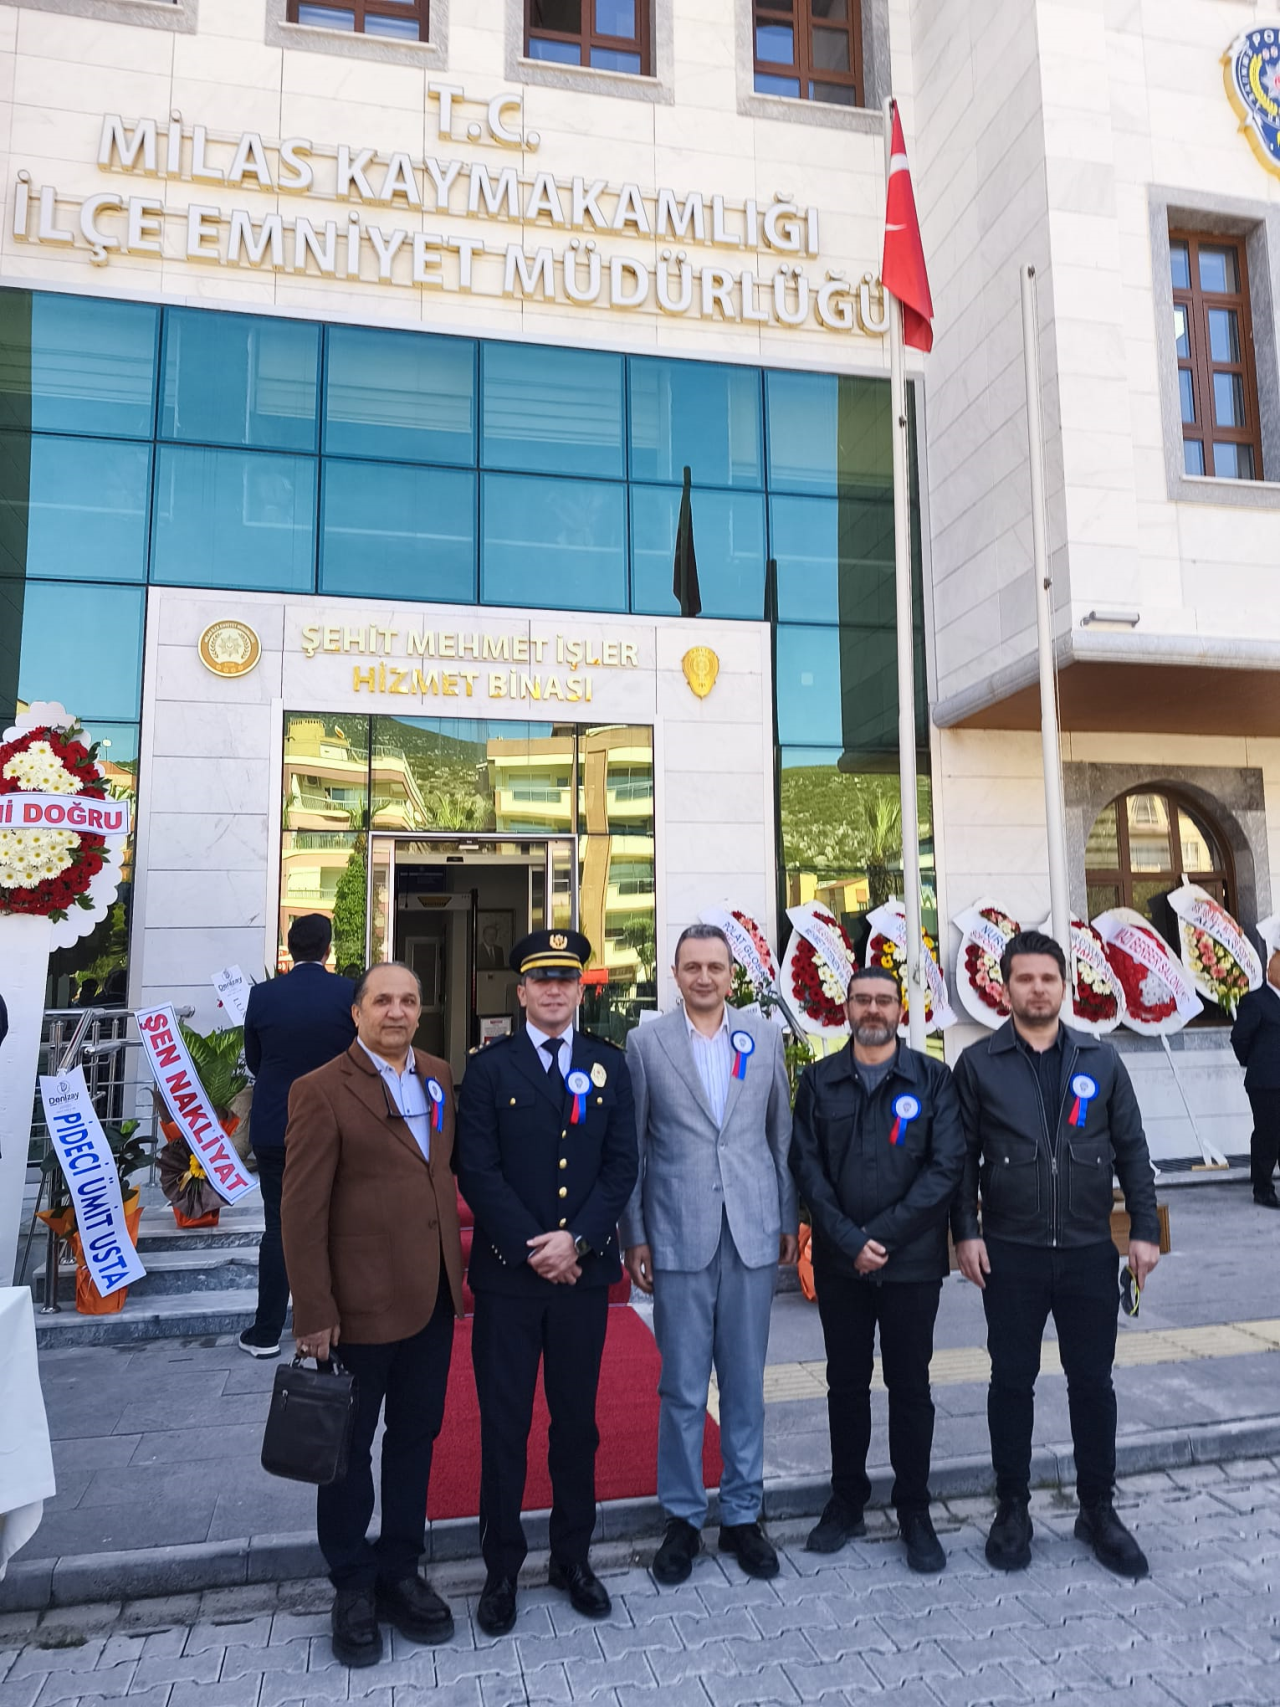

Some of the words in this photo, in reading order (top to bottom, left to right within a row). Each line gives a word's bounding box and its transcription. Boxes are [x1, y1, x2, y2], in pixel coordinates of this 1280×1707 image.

[428, 82, 541, 153] T.C.
[98, 109, 313, 193] MİLAS
[336, 144, 820, 258] KAYMAKAMLIĞI
[13, 169, 165, 266] İLÇE
[187, 203, 485, 294] EMNİYET
[502, 237, 890, 337] MÜDÜRLÜĞÜ
[302, 623, 398, 658] ŞEHİT
[406, 629, 549, 662] MEHMET
[556, 633, 639, 671] İŞLER
[353, 660, 480, 697] HİZMET
[488, 667, 592, 702] BİNASI
[23, 801, 122, 830] DOĞRU
[139, 1013, 181, 1068] ŞEN
[165, 1069, 248, 1192] NAKLİYAT
[53, 1112, 109, 1176] PİDECİ
[77, 1177, 119, 1230] ÜMİT
[90, 1231, 130, 1289] USTA
